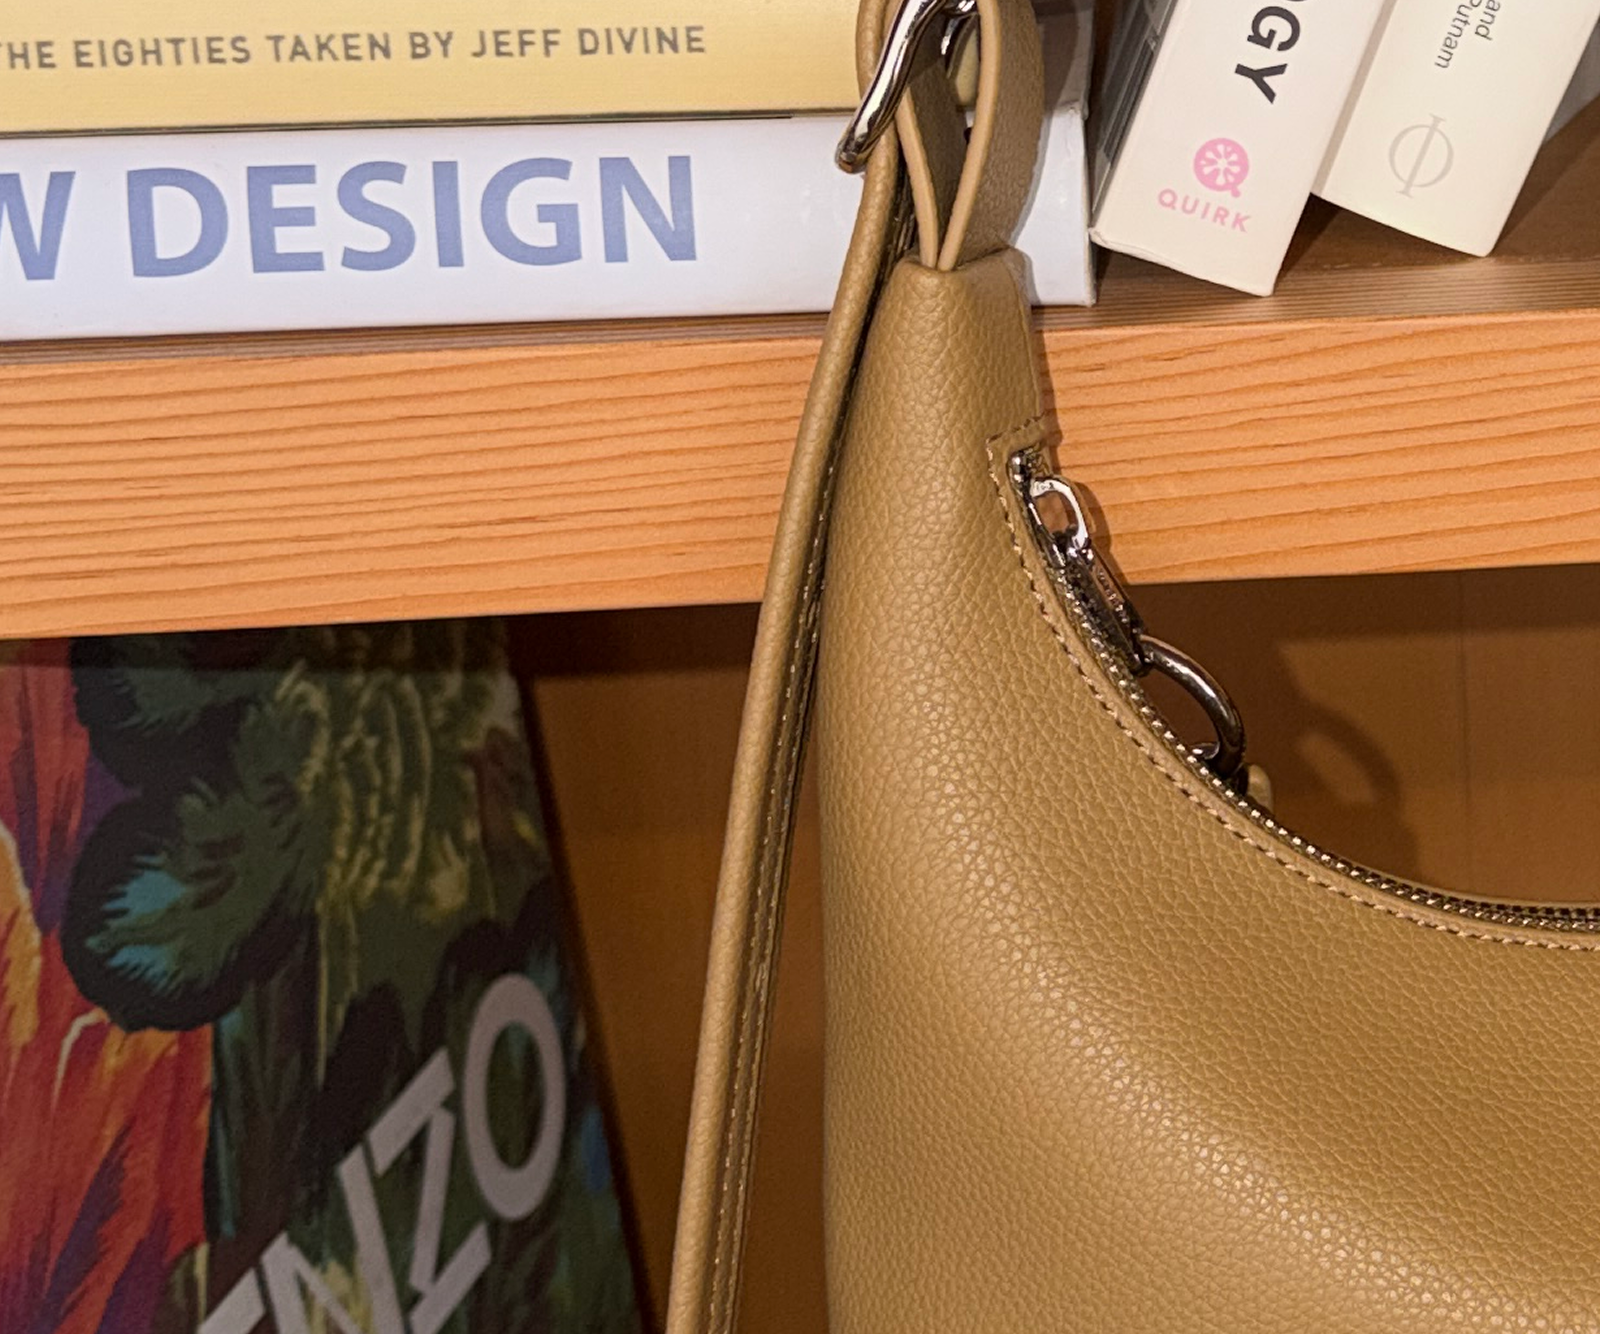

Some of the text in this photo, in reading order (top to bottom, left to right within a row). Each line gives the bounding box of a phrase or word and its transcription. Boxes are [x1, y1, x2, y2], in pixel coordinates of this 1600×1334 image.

[0, 24, 706, 70] HE EIGHTIES TAKEN BY JEFF DIVINE
[126, 154, 698, 279] DESIGN
[1157, 188, 1251, 233] QUIRK
